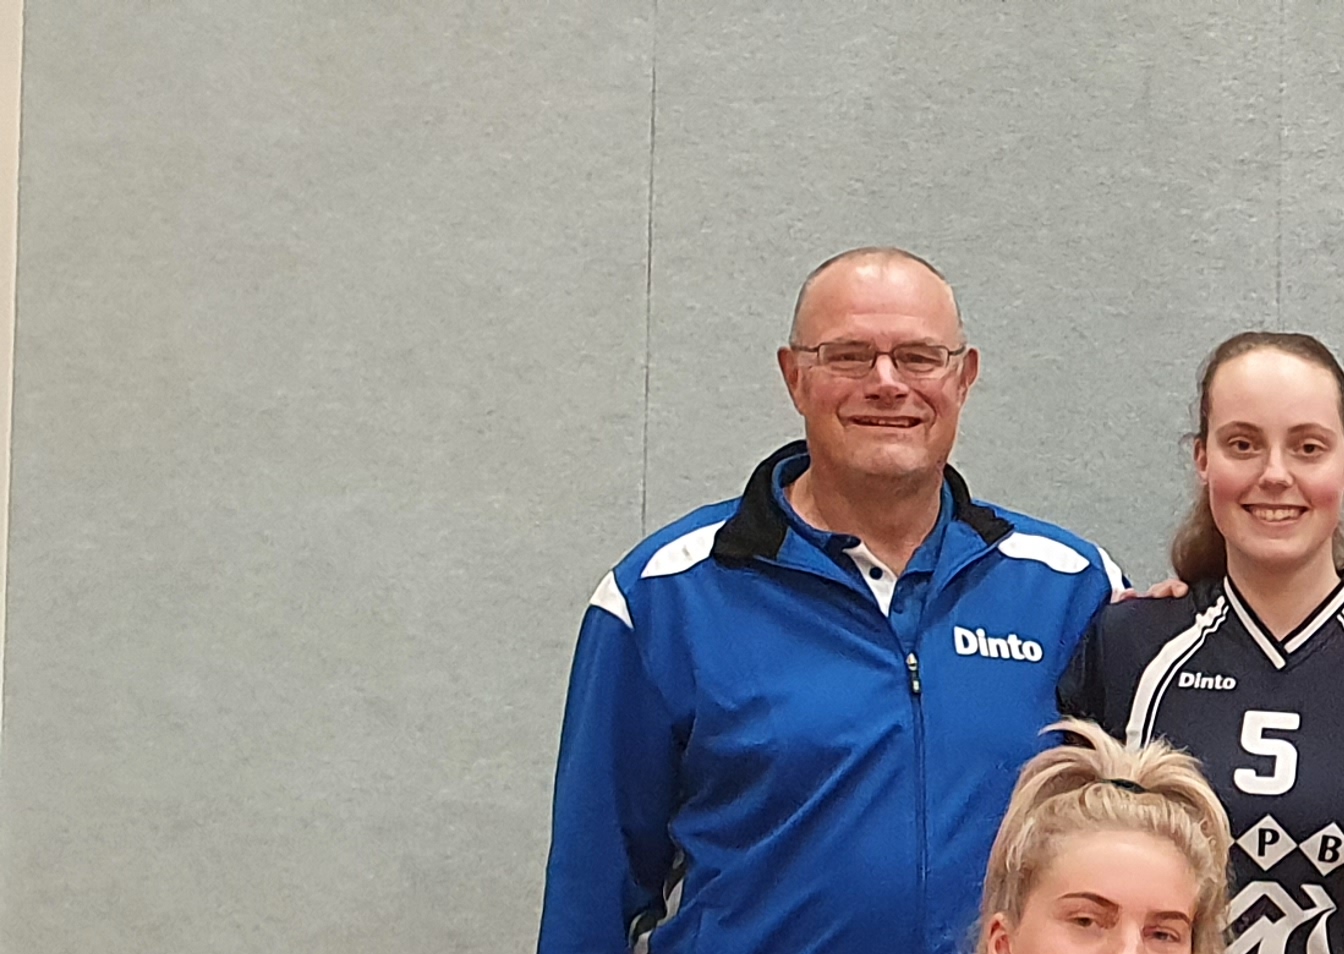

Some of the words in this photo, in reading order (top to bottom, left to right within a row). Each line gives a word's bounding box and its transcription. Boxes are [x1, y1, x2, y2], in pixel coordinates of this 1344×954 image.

[954, 626, 1043, 662] Dinto
[1178, 671, 1237, 690] Dinto
[1233, 710, 1300, 795] 5
